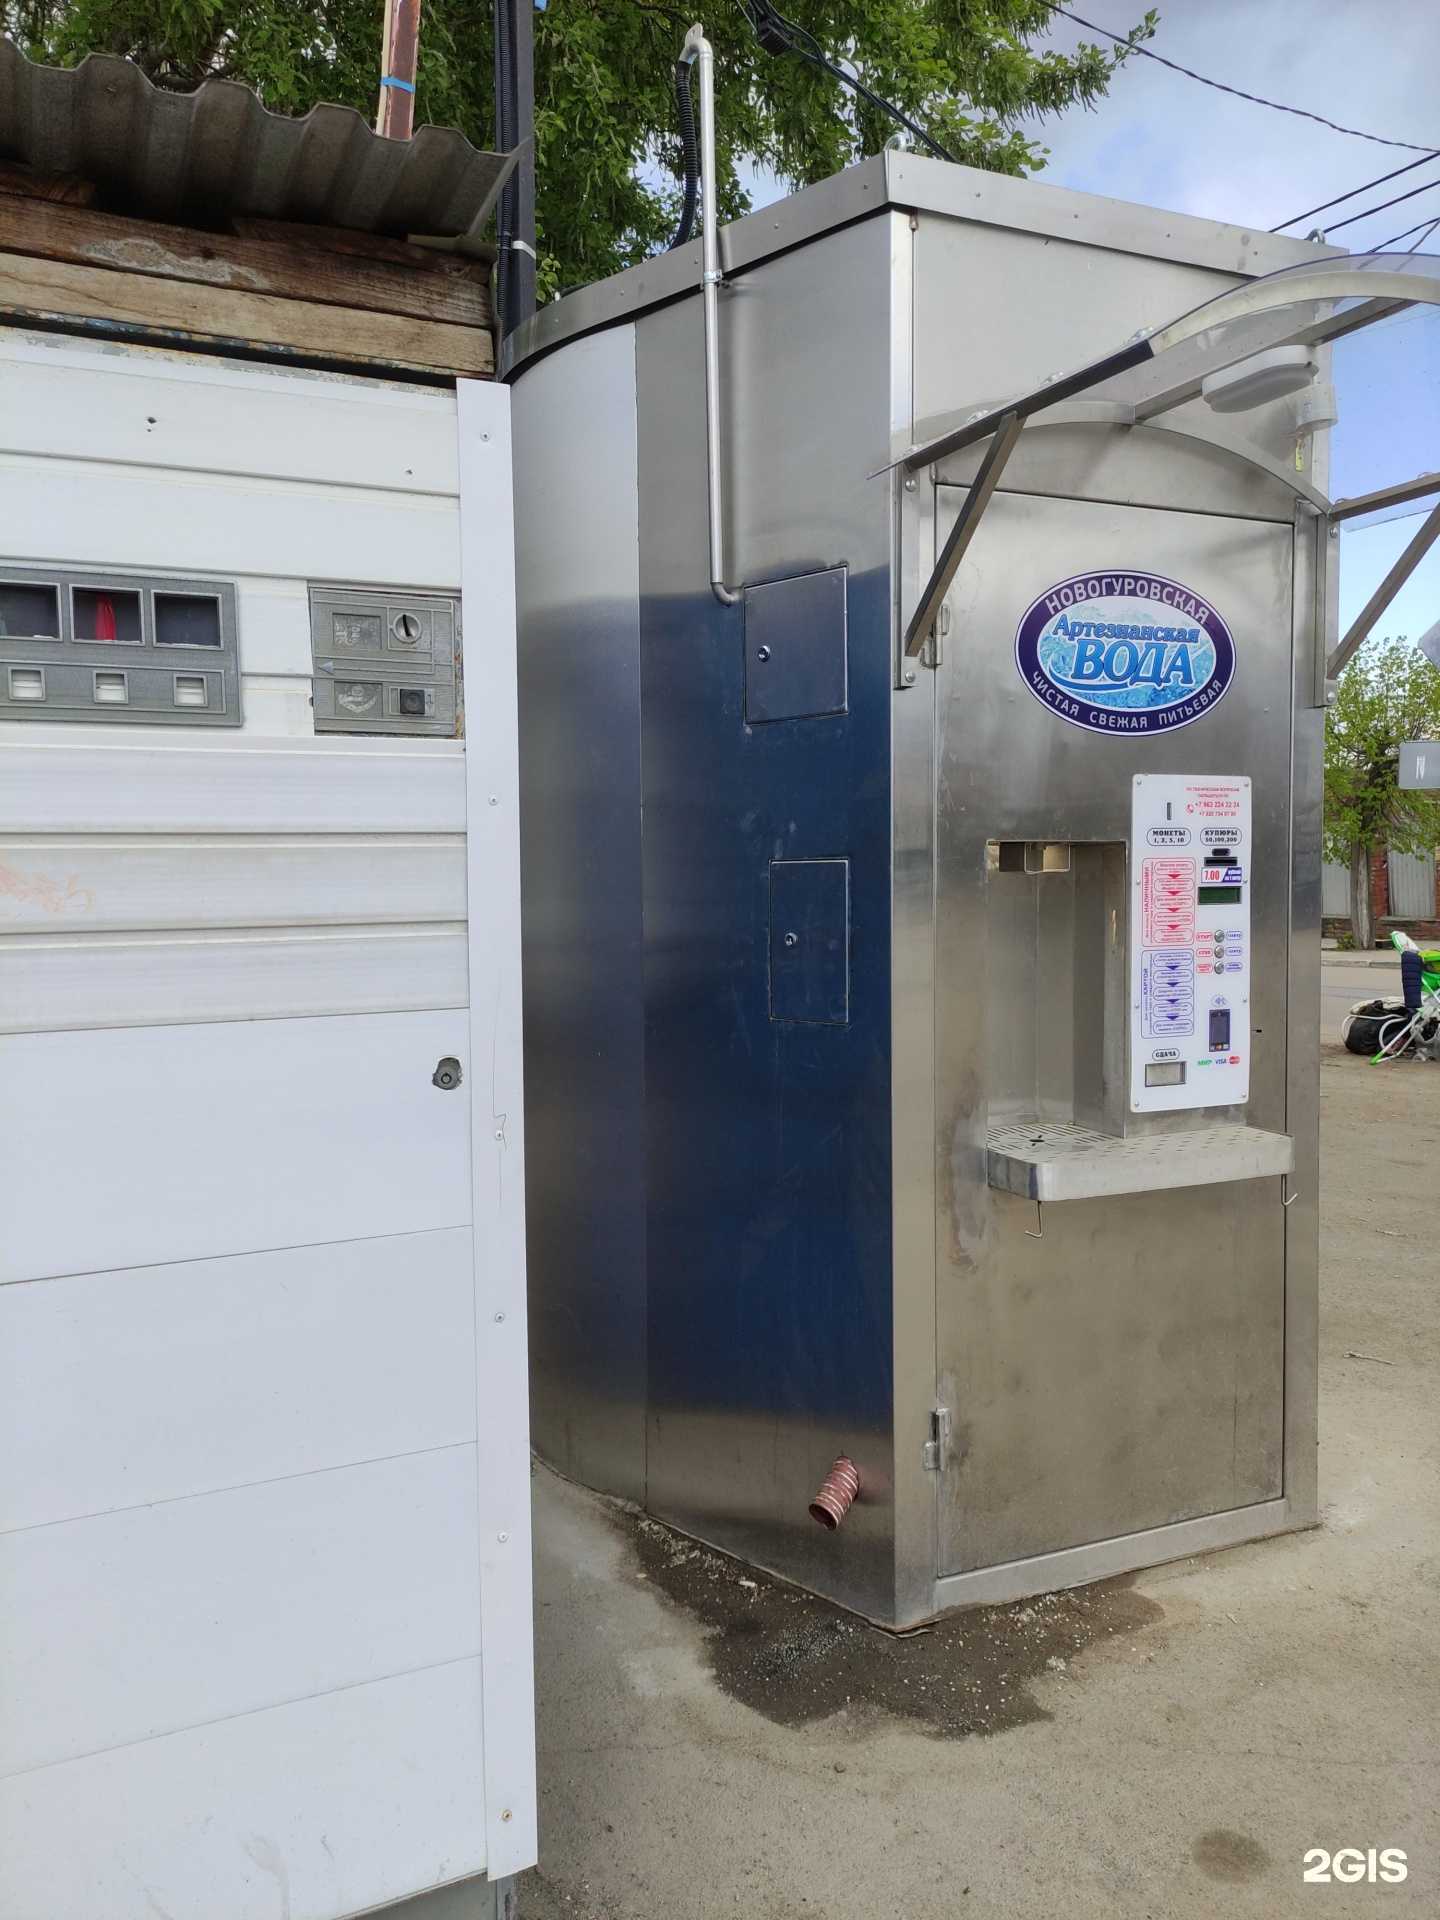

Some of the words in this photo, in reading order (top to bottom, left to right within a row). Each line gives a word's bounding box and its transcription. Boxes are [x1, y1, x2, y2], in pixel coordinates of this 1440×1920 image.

[1044, 577, 1210, 625] НОВОГУРОВСКАЯ
[1070, 638, 1194, 688] ВОДА
[1032, 671, 1080, 717] ЧИСТАЯ
[1089, 711, 1148, 729] СВЕЖАЯ
[1158, 680, 1223, 726] ПИТЬЕВАЯ
[1204, 870, 1220, 881] 7.00
